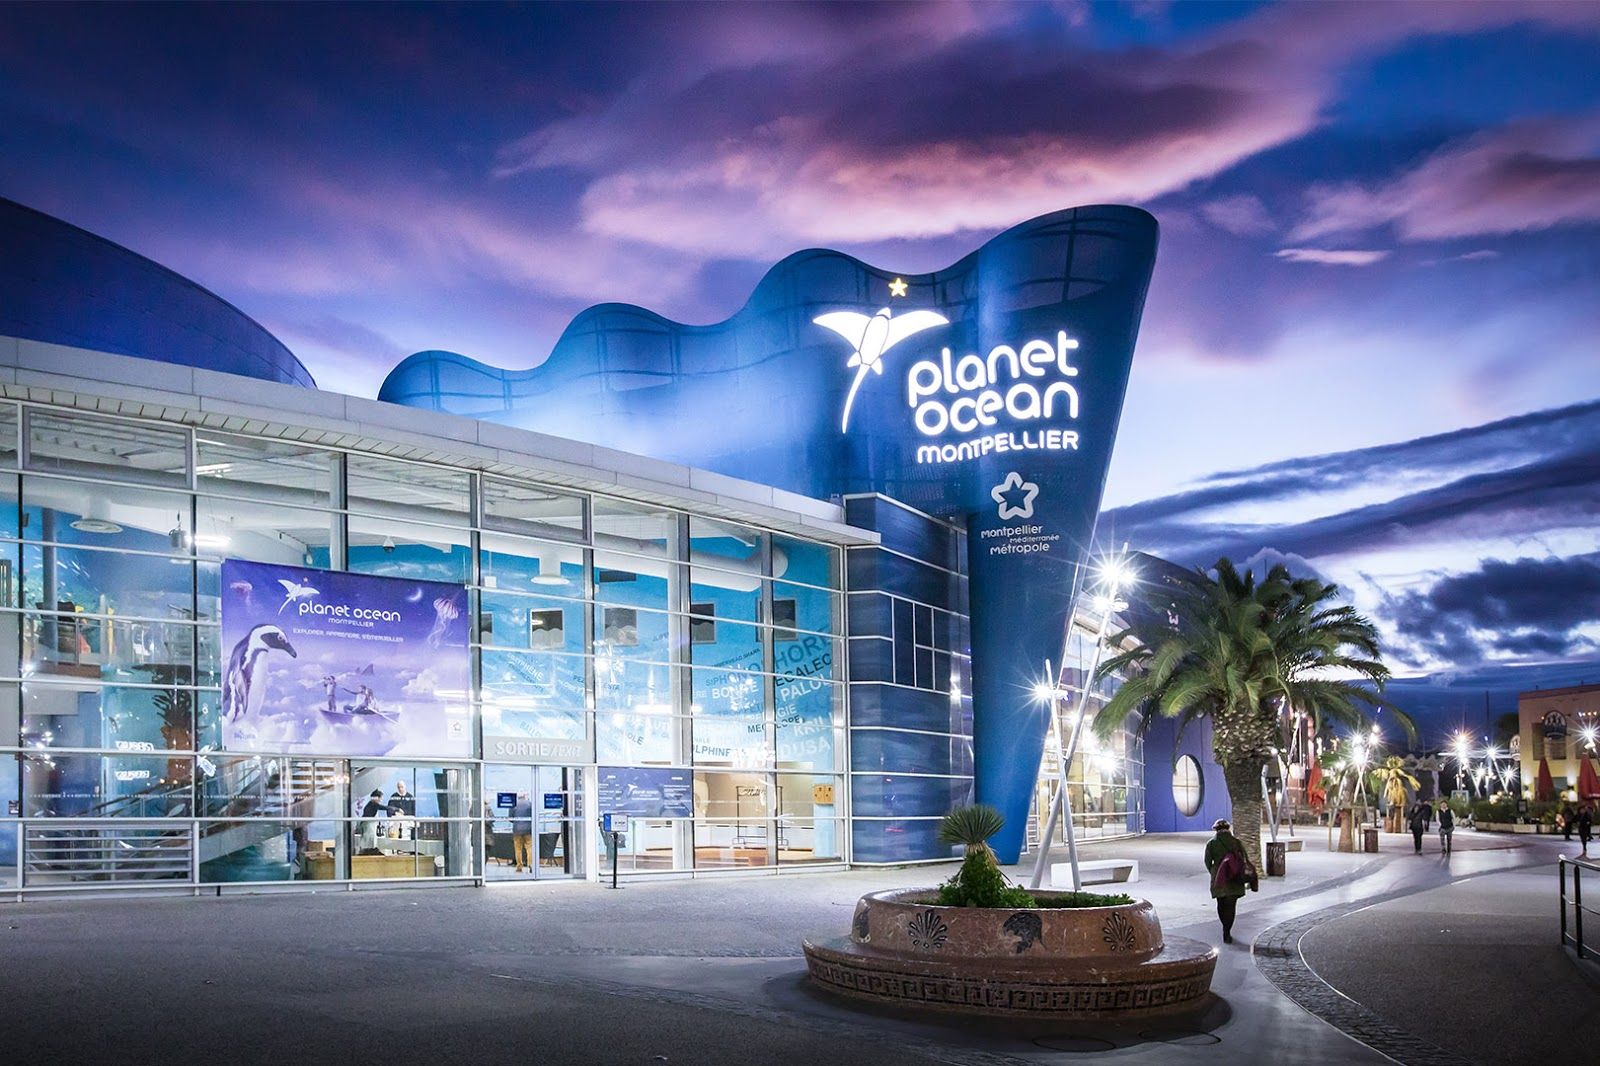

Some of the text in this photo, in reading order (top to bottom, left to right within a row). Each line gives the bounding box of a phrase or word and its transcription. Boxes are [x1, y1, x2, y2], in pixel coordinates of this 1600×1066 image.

[908, 330, 1080, 408] planet
[914, 380, 1079, 436] ocean
[981, 523, 1043, 539] montpellier
[989, 540, 1050, 555] métropole
[299, 600, 401, 622] planet ocean
